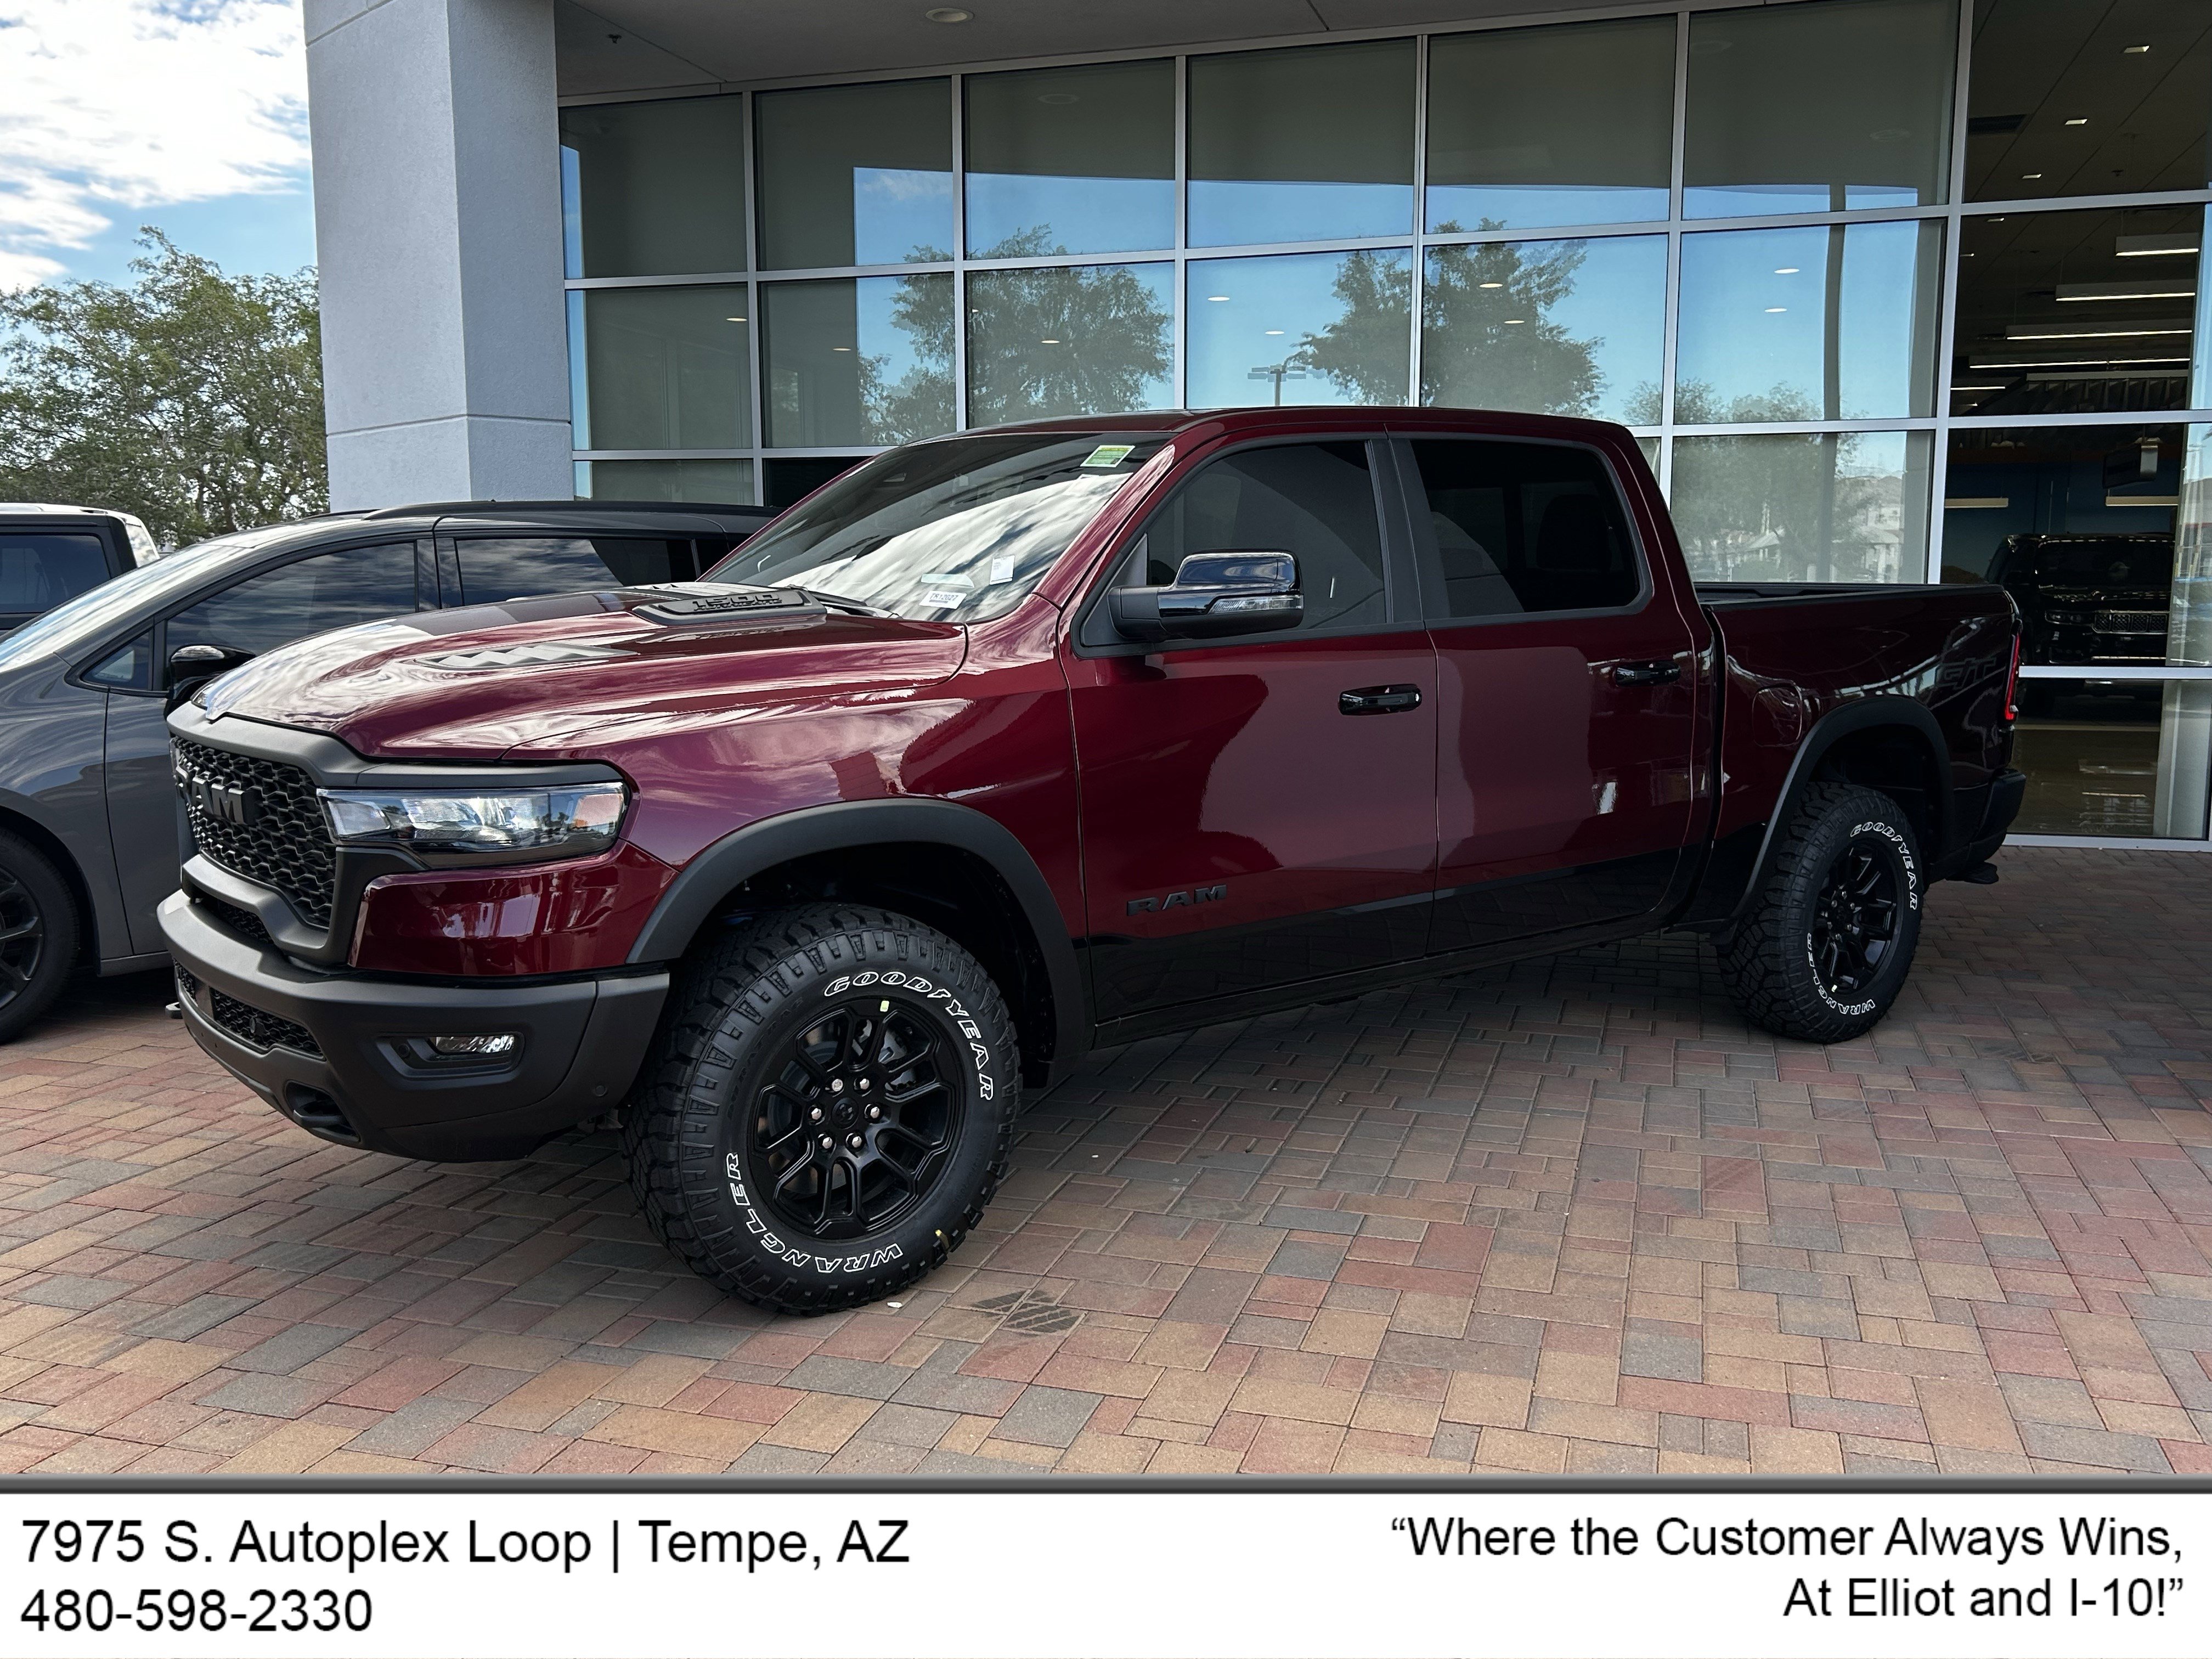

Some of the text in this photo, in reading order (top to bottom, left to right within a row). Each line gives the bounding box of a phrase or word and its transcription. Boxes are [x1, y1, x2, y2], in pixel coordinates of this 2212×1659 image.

[692, 594, 780, 608] 1500
[176, 766, 245, 825] RAM
[1127, 884, 1227, 916] RAM
[1850, 821, 1918, 911] GOODYEAR
[1807, 932, 1875, 1015] WRANGLER
[824, 971, 994, 1101] GOODYEAR
[726, 1152, 904, 1273] WRANGLER
